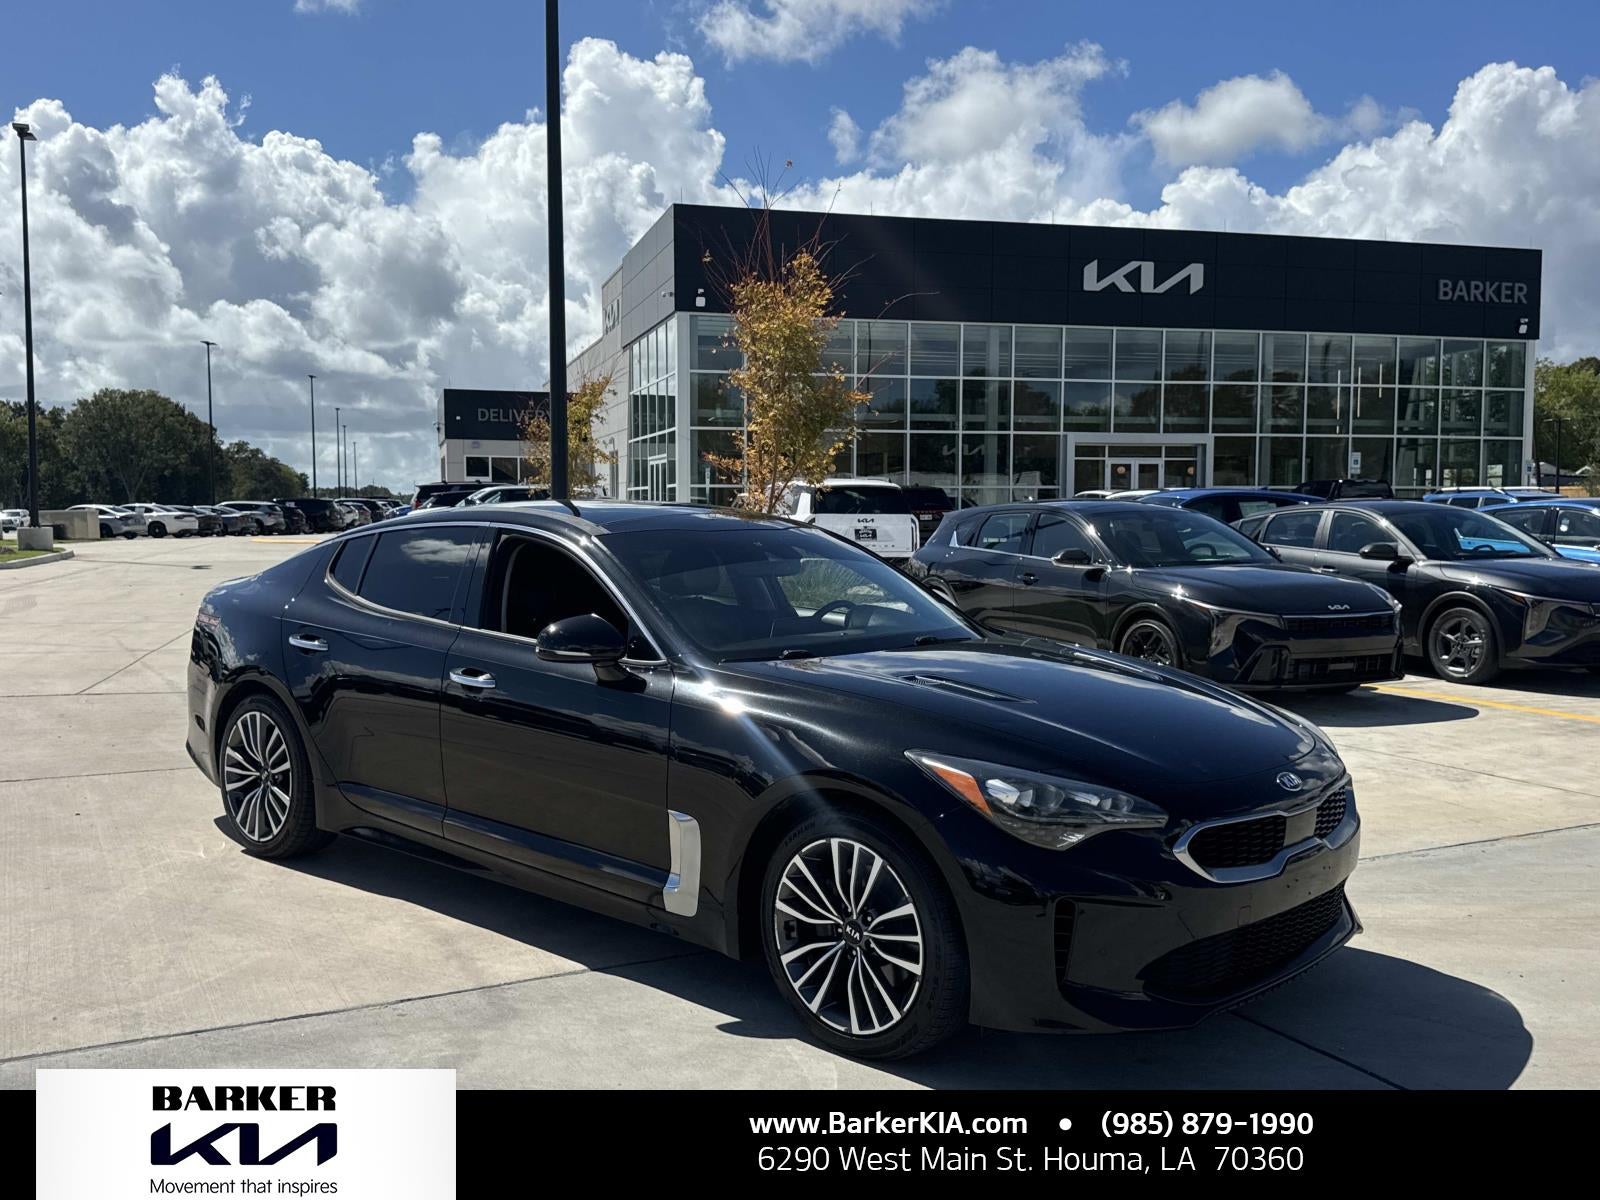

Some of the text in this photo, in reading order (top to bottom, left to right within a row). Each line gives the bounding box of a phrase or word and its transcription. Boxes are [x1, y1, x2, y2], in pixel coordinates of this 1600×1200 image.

[1083, 258, 1204, 295] KIA
[1438, 279, 1528, 304] BARKER
[845, 925, 860, 940] KIA
